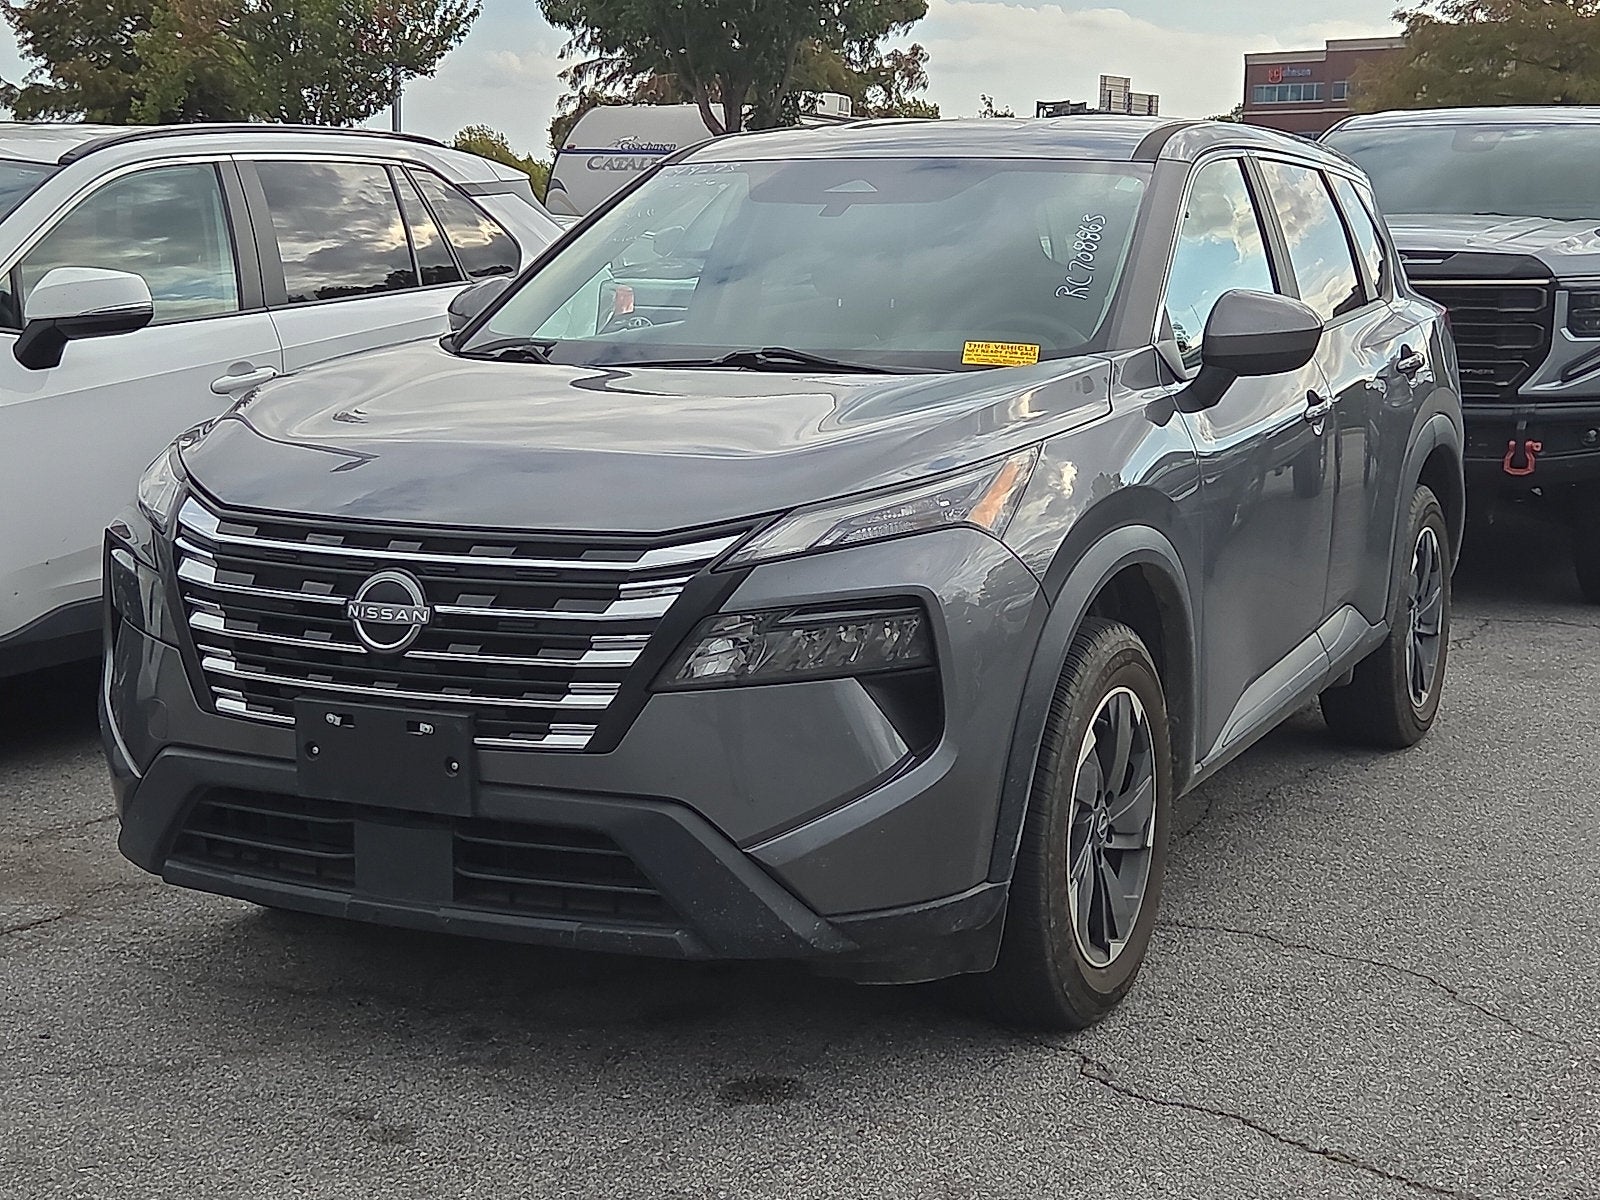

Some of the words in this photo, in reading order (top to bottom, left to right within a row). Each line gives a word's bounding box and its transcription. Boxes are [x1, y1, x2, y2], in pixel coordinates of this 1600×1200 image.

[620, 141, 677, 151] Coachmen
[994, 344, 1037, 352] VEHICLE
[347, 604, 428, 622] NISSAN
